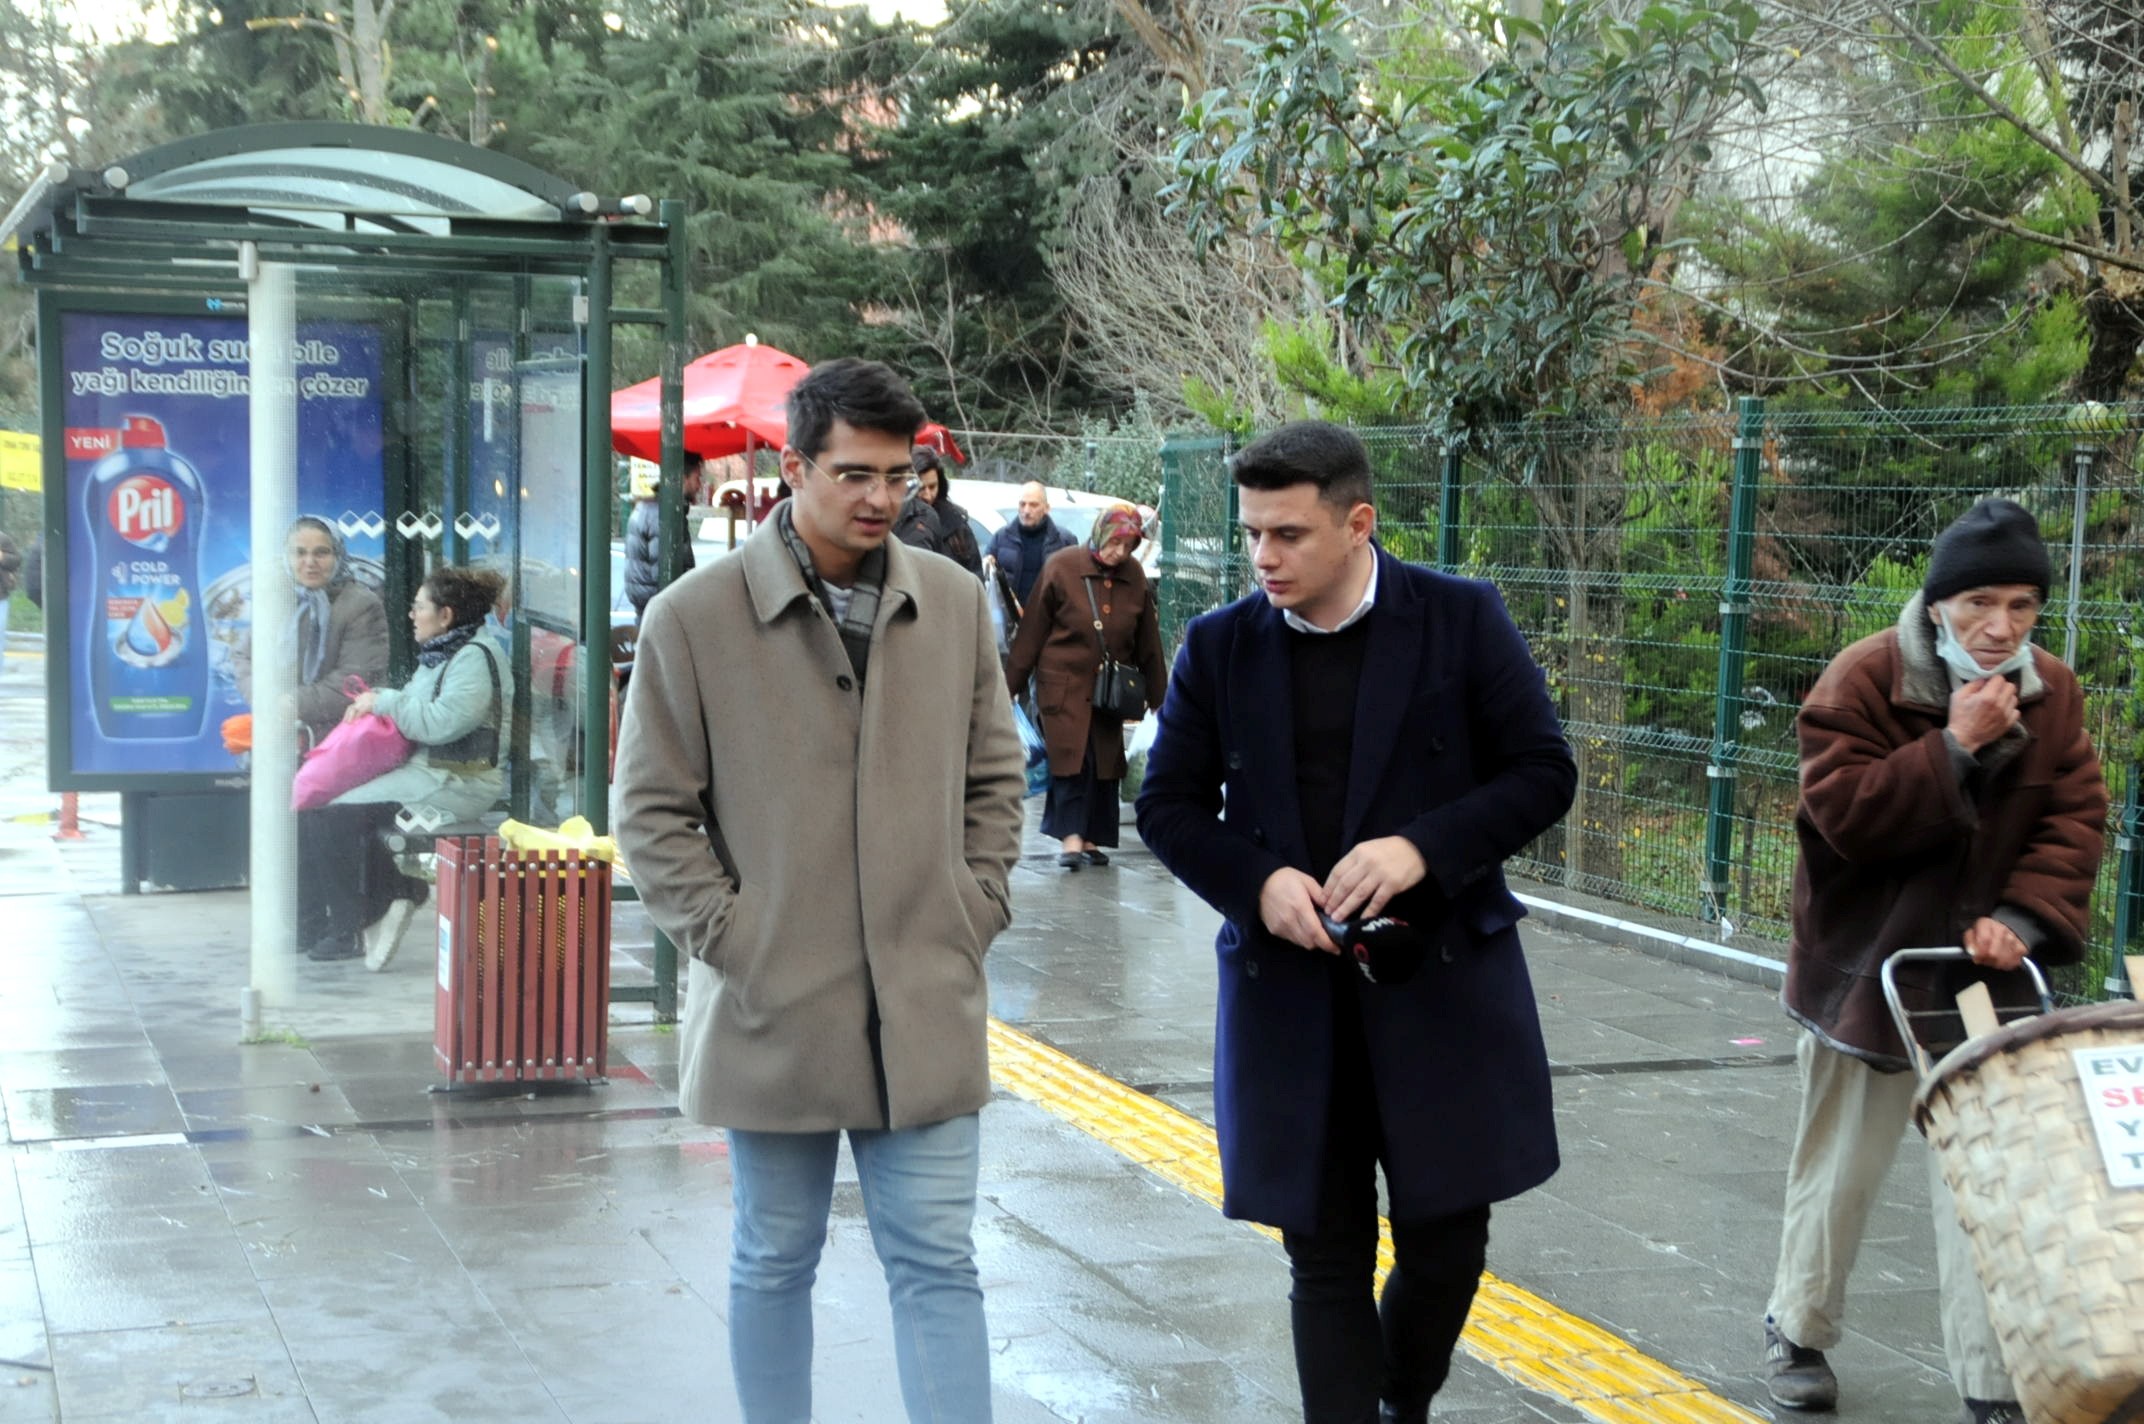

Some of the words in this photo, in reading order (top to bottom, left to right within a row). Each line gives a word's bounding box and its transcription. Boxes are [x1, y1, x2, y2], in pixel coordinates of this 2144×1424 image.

[101, 331, 204, 366] Soğuk
[71, 367, 128, 396] yağı
[301, 371, 369, 400] çözer
[71, 435, 112, 450] YENİ
[118, 487, 173, 533] Pril
[130, 561, 168, 573] COLD
[131, 573, 181, 585] POWER
